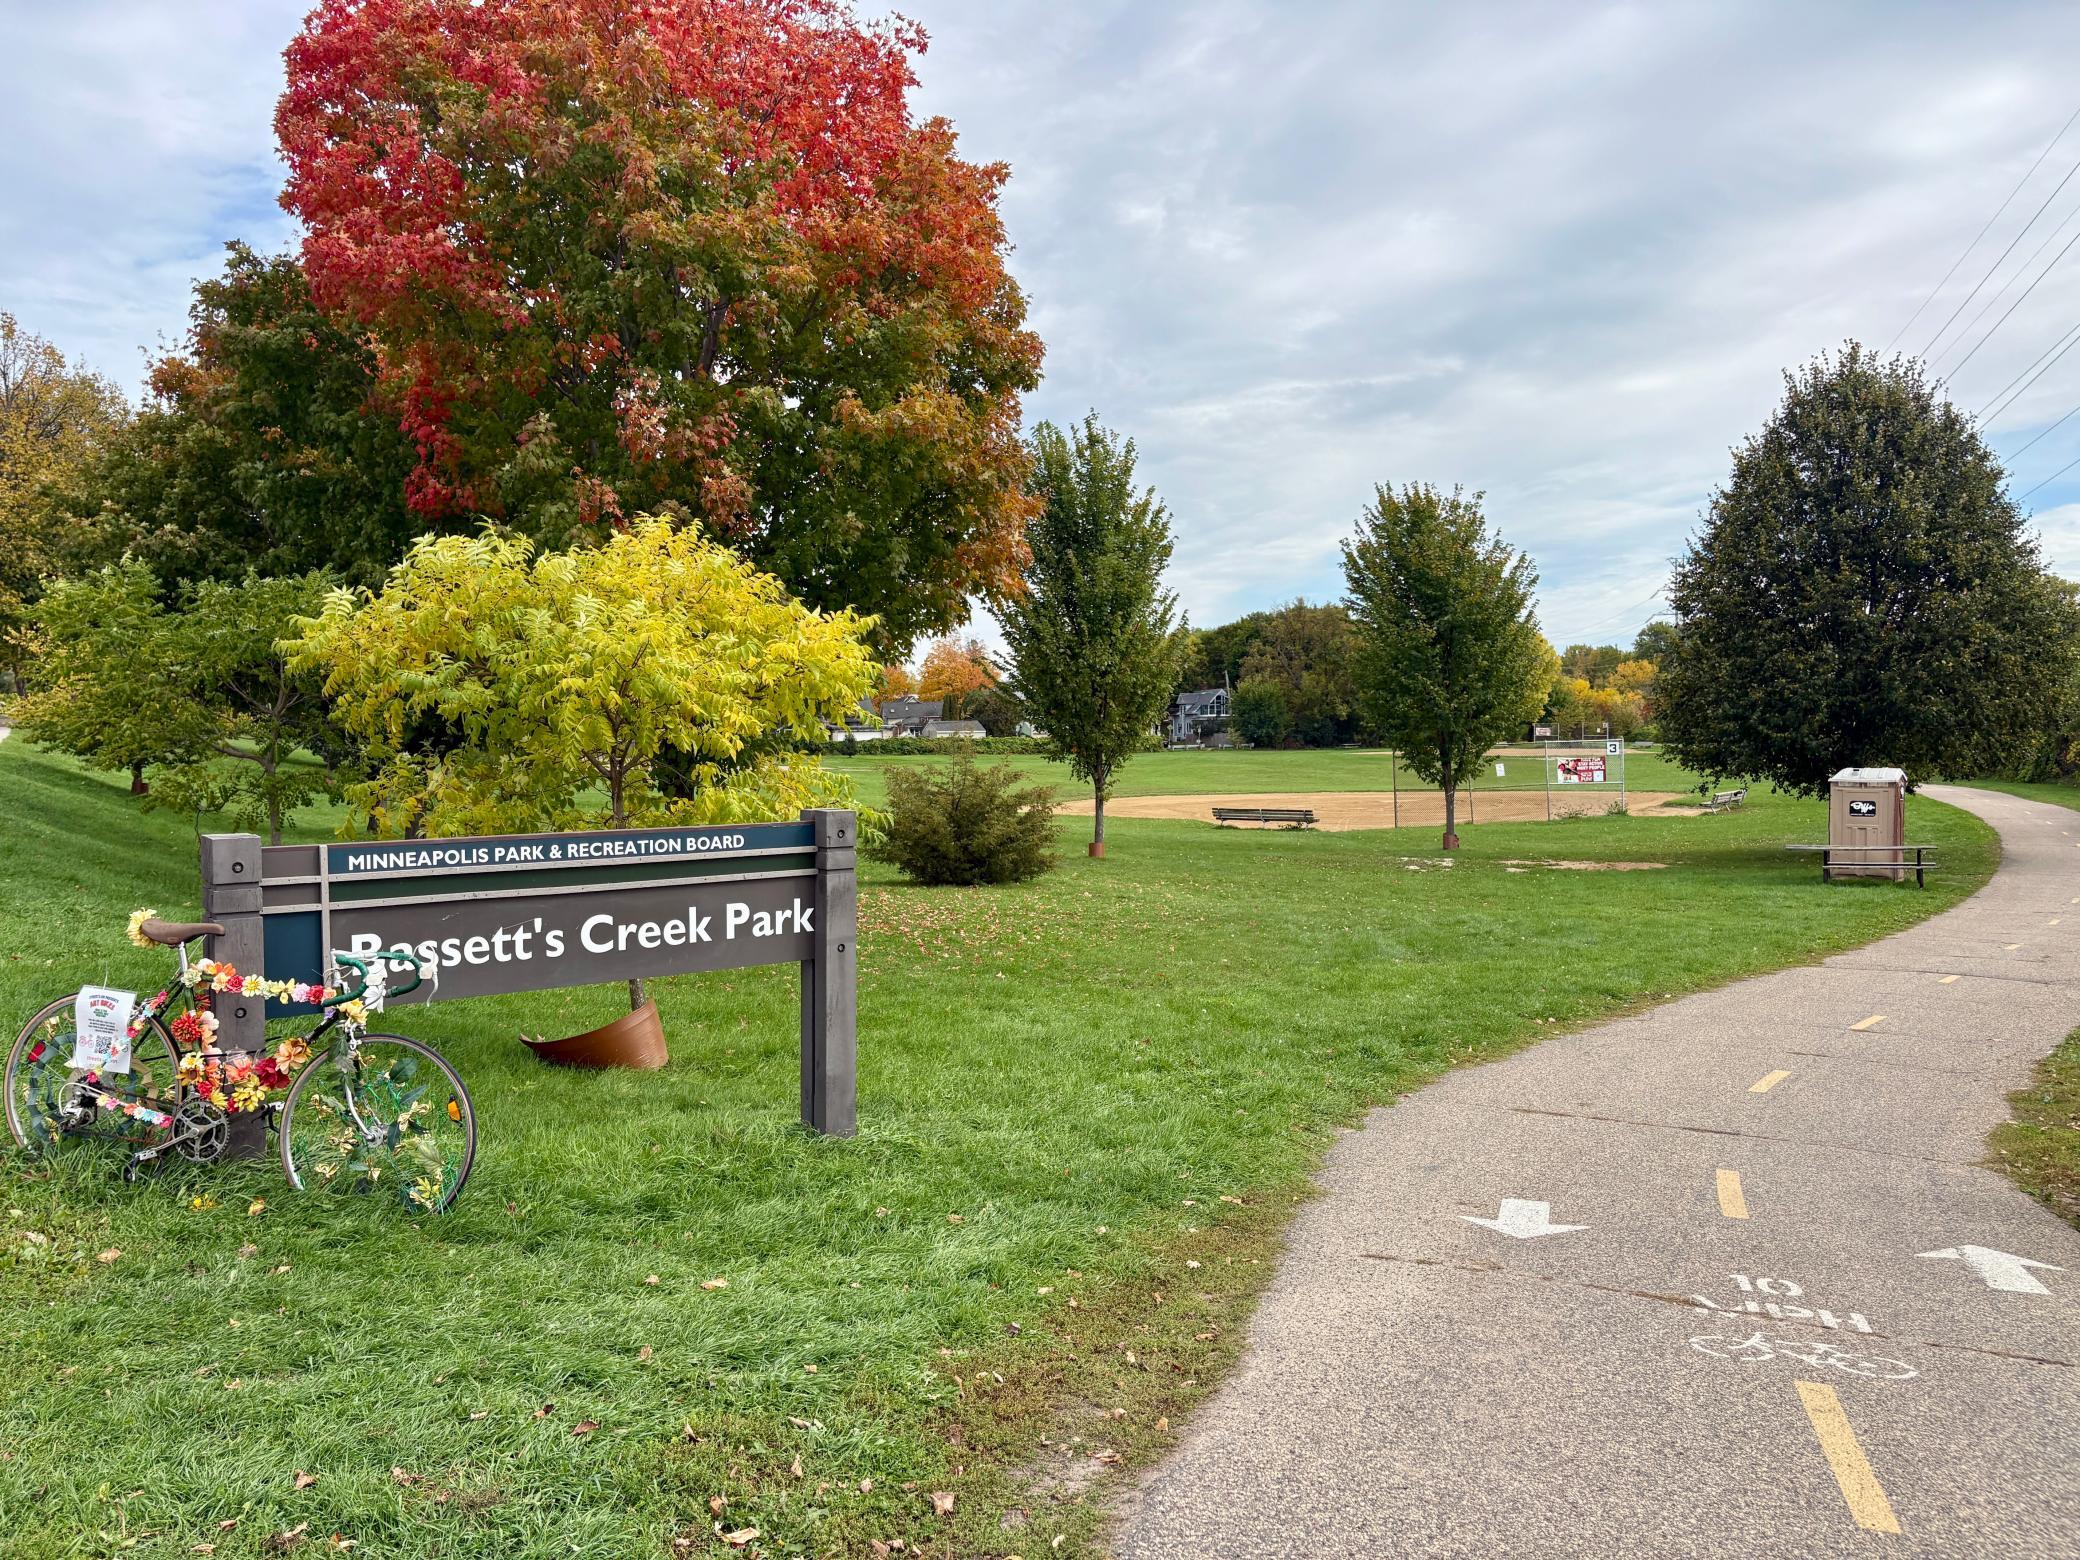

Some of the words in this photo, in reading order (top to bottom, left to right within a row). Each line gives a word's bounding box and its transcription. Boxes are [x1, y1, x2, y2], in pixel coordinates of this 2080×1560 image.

[1609, 743, 1617, 753] 3
[349, 847, 489, 871] MINNEAPOLIS
[494, 845, 545, 862] PARK
[549, 844, 562, 859] &
[567, 838, 682, 858] RECREATION
[686, 834, 745, 851] BOARD
[351, 917, 565, 977] Bassett's
[580, 906, 712, 954] Creek
[726, 897, 815, 940] Park
[1729, 1273, 1803, 1297] 10
